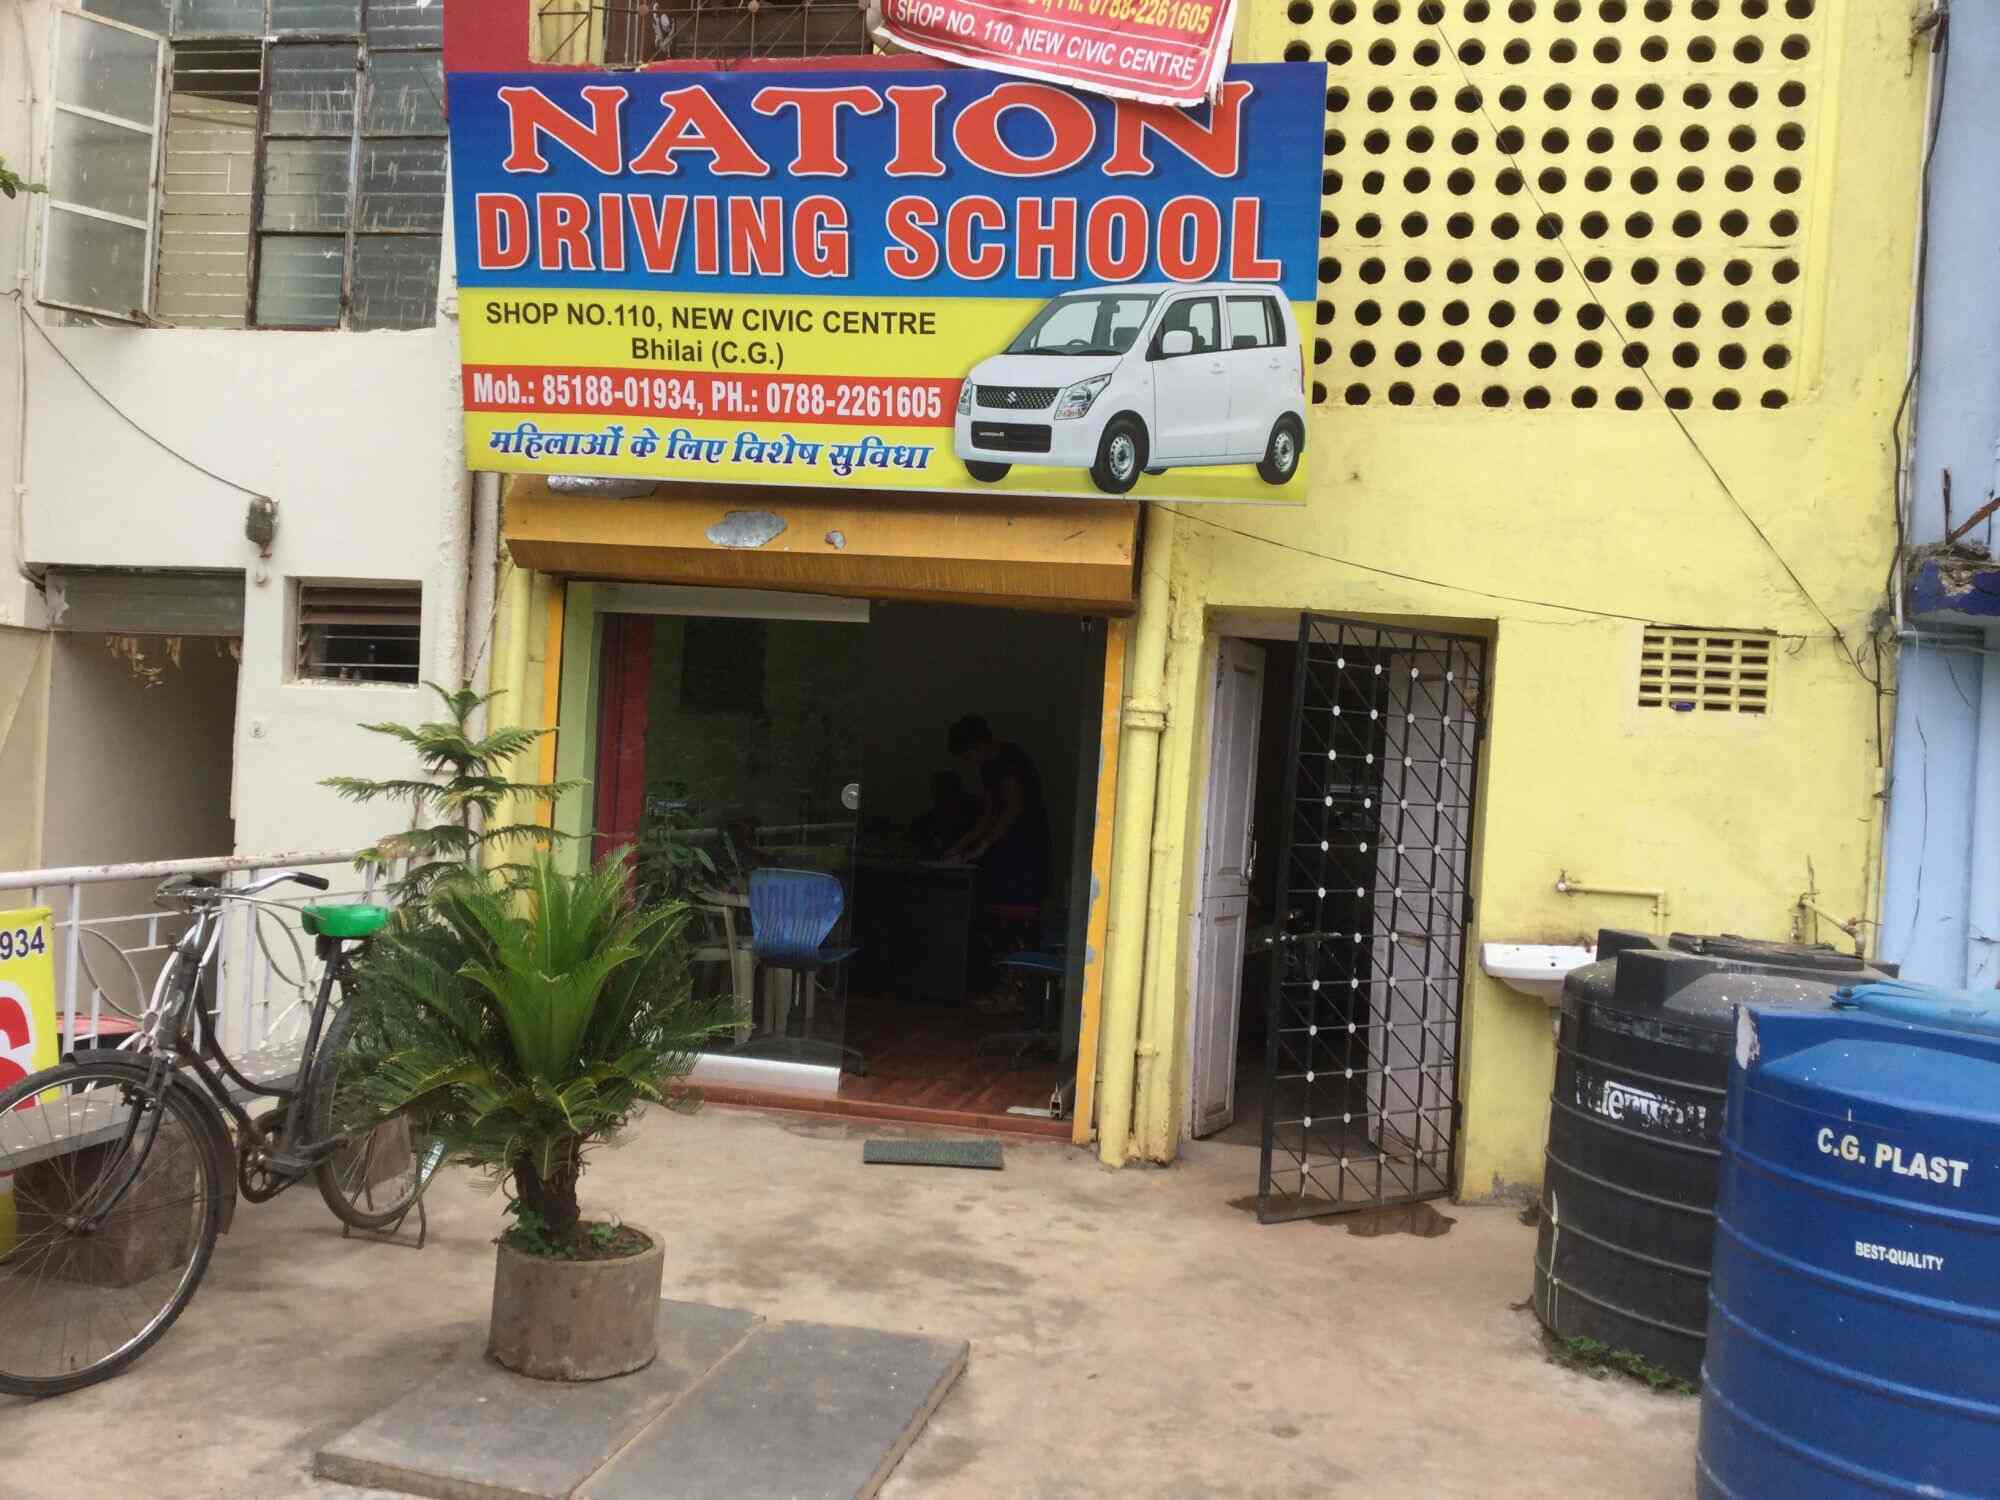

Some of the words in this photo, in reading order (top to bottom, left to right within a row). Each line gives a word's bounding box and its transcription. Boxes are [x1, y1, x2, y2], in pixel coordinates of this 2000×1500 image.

[896, 1, 944, 27] SHOP
[946, 10, 976, 37] NO.
[984, 19, 1015, 49] 110,
[1019, 25, 1065, 53] NEW
[1066, 36, 1117, 66] CIVIC
[1119, 47, 1198, 81] CENTRE
[497, 81, 1254, 178] NATION
[475, 192, 849, 278] DRIVING
[884, 195, 1282, 282] SCHOOL
[486, 302, 558, 324] SHOP
[567, 303, 663, 331] NO.110,
[672, 306, 733, 330] NEW
[742, 308, 813, 332] CIVIC
[823, 310, 936, 335] CENTRE
[632, 337, 703, 362] Bhilai
[712, 341, 784, 370] (C.G.)
[473, 373, 535, 405] Mob.:
[542, 373, 704, 416] 85188-01934,
[711, 380, 758, 413] PH.:
[766, 382, 941, 418] 0788-2261605
[489, 423, 625, 459] महिलाओं
[630, 428, 660, 458] के
[665, 429, 728, 464] लिए
[731, 431, 825, 466] विशेष
[829, 436, 934, 476] सुविधा
[1817, 1127, 1867, 1164] C.G.
[1874, 1143, 1969, 1187] PLAST
[1855, 1241, 1944, 1271] BEST-QUALITY
